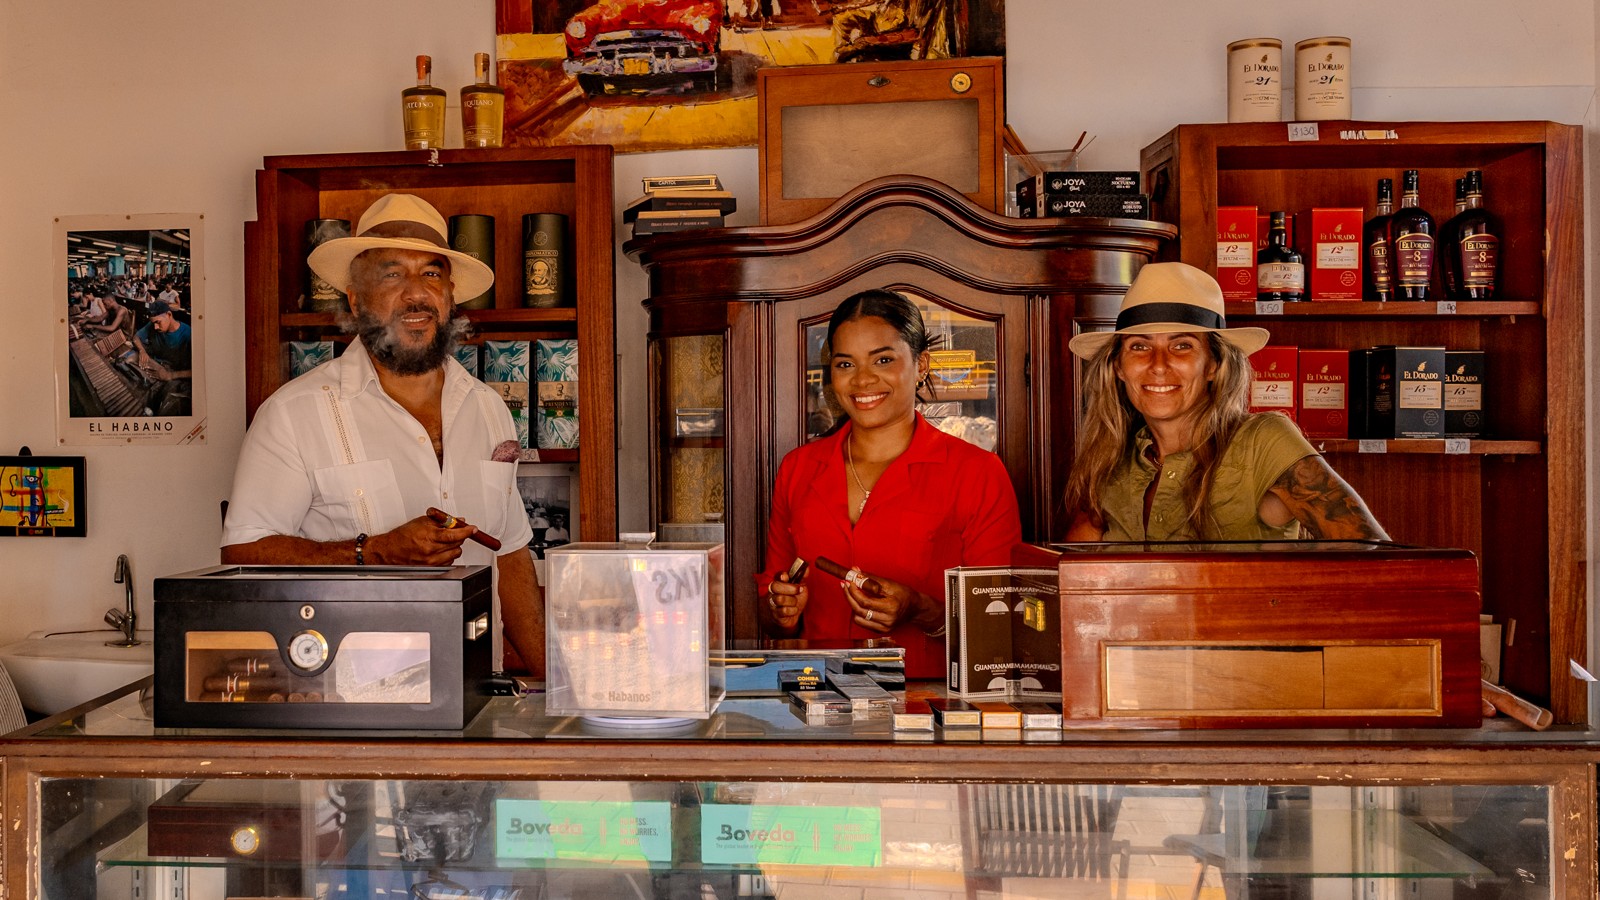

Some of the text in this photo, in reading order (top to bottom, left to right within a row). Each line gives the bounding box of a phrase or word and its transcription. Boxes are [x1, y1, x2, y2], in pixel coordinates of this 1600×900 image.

[1254, 64, 1279, 72] DORADO
[1309, 63, 1344, 72] EL DORADO
[1256, 77, 1271, 85] 21
[1319, 75, 1335, 84] 21
[1292, 127, 1314, 136] $130
[1414, 251, 1421, 261] 8
[1480, 251, 1486, 262] 8
[1404, 371, 1438, 380] EL DORADO
[1265, 384, 1278, 392] 12
[1414, 385, 1426, 393] 15
[90, 422, 173, 432] EL HABANO
[608, 691, 650, 702] Habanos
[506, 818, 583, 835] Boveda
[716, 824, 795, 842] Boveda
